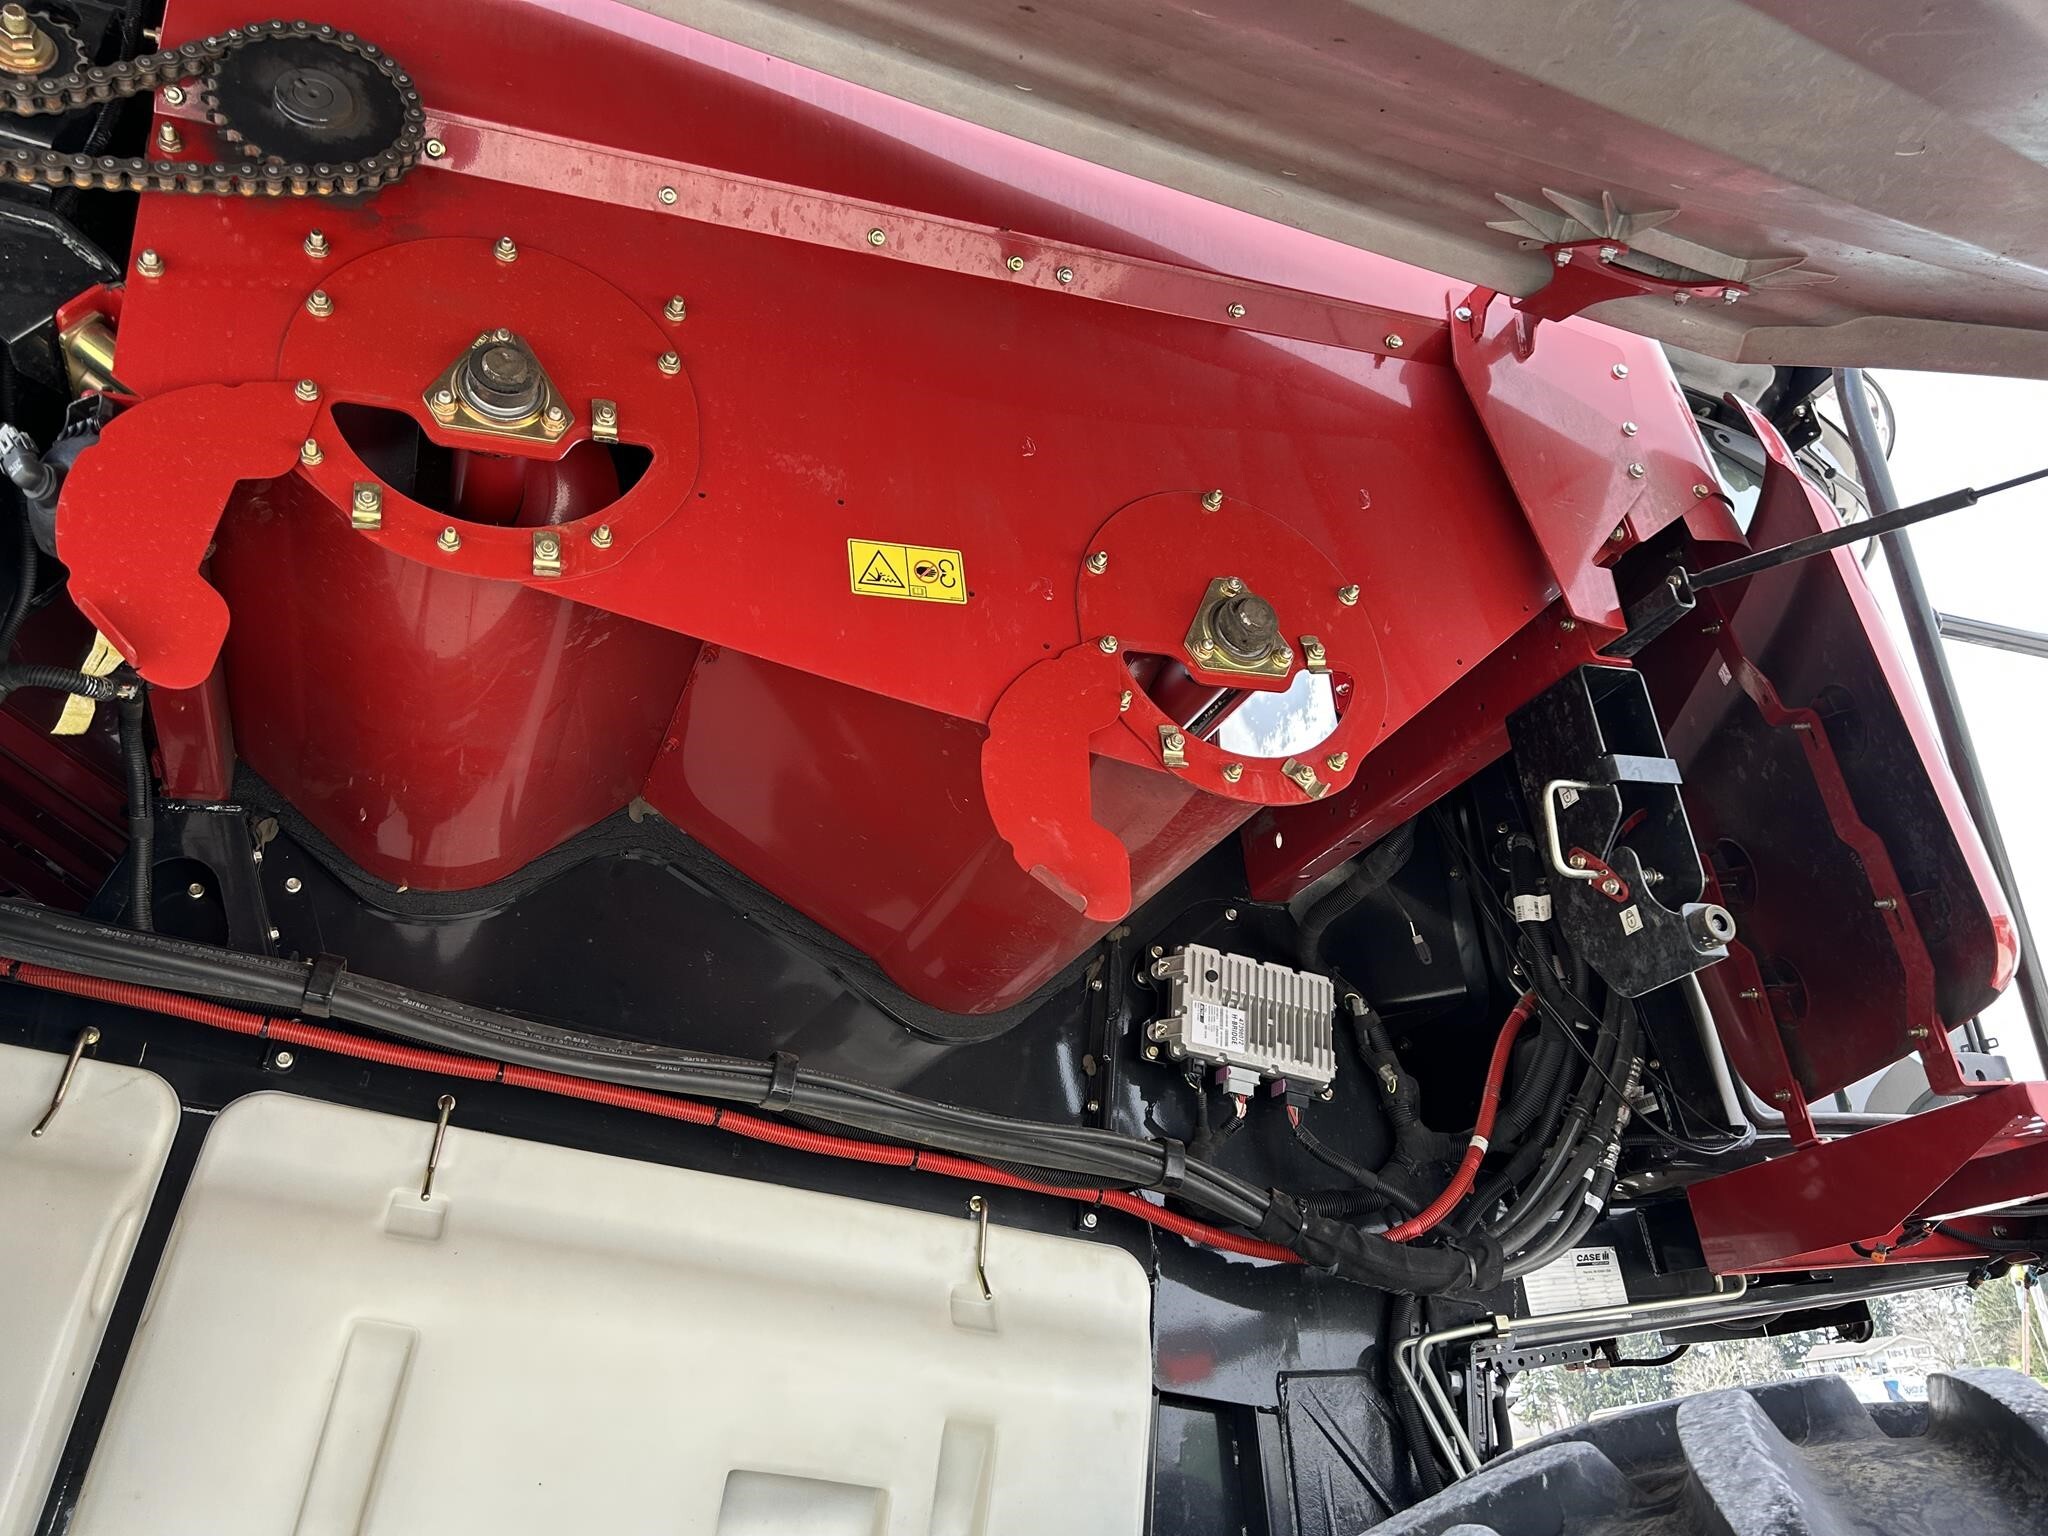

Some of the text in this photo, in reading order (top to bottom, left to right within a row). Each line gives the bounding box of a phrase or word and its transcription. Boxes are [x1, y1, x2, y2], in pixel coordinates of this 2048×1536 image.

[97, 927, 131, 939] Parker
[401, 997, 430, 1010] Parker
[1576, 1253, 1601, 1262] CASE
